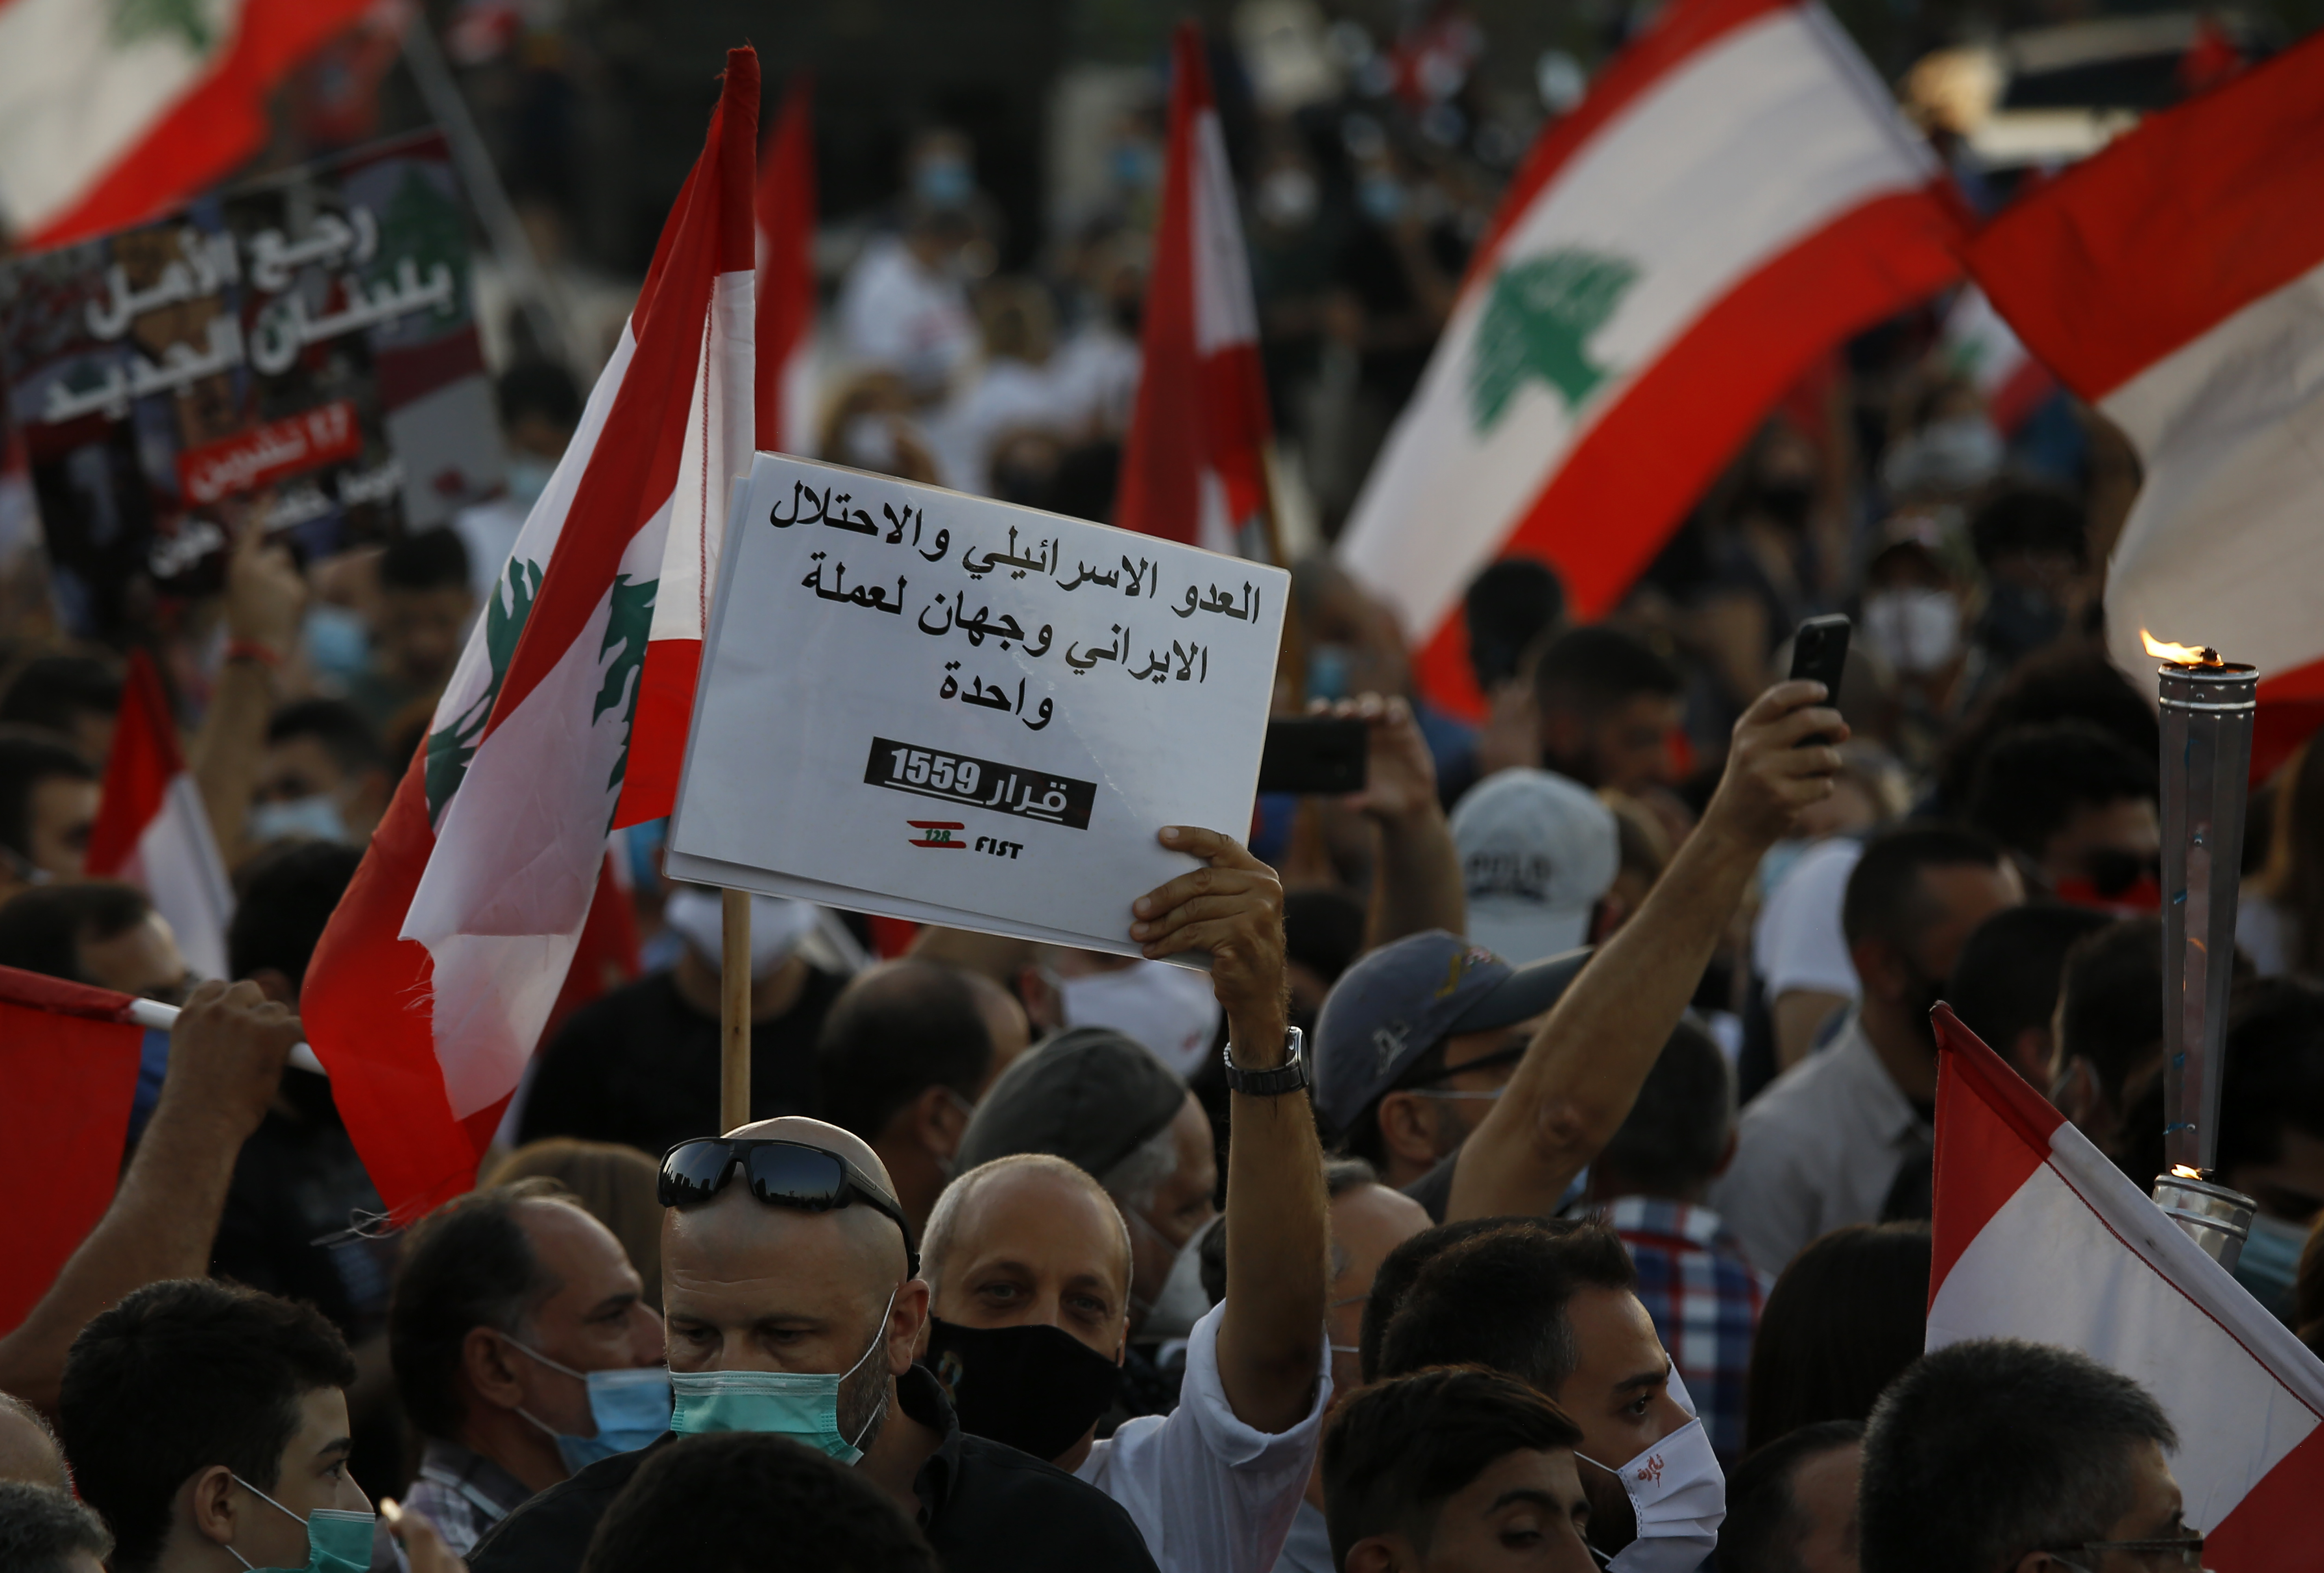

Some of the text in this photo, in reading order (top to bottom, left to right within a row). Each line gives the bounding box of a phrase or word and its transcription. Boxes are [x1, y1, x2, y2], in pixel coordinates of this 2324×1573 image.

[769, 479, 1260, 625] العدو الاسرائيلي والاحتلال
[801, 550, 1208, 685] الايراني وجهان لعملة
[939, 660, 1054, 731] واحدة
[891, 748, 1067, 813] قرار 1559
[925, 829, 1023, 859] 128 FIST
